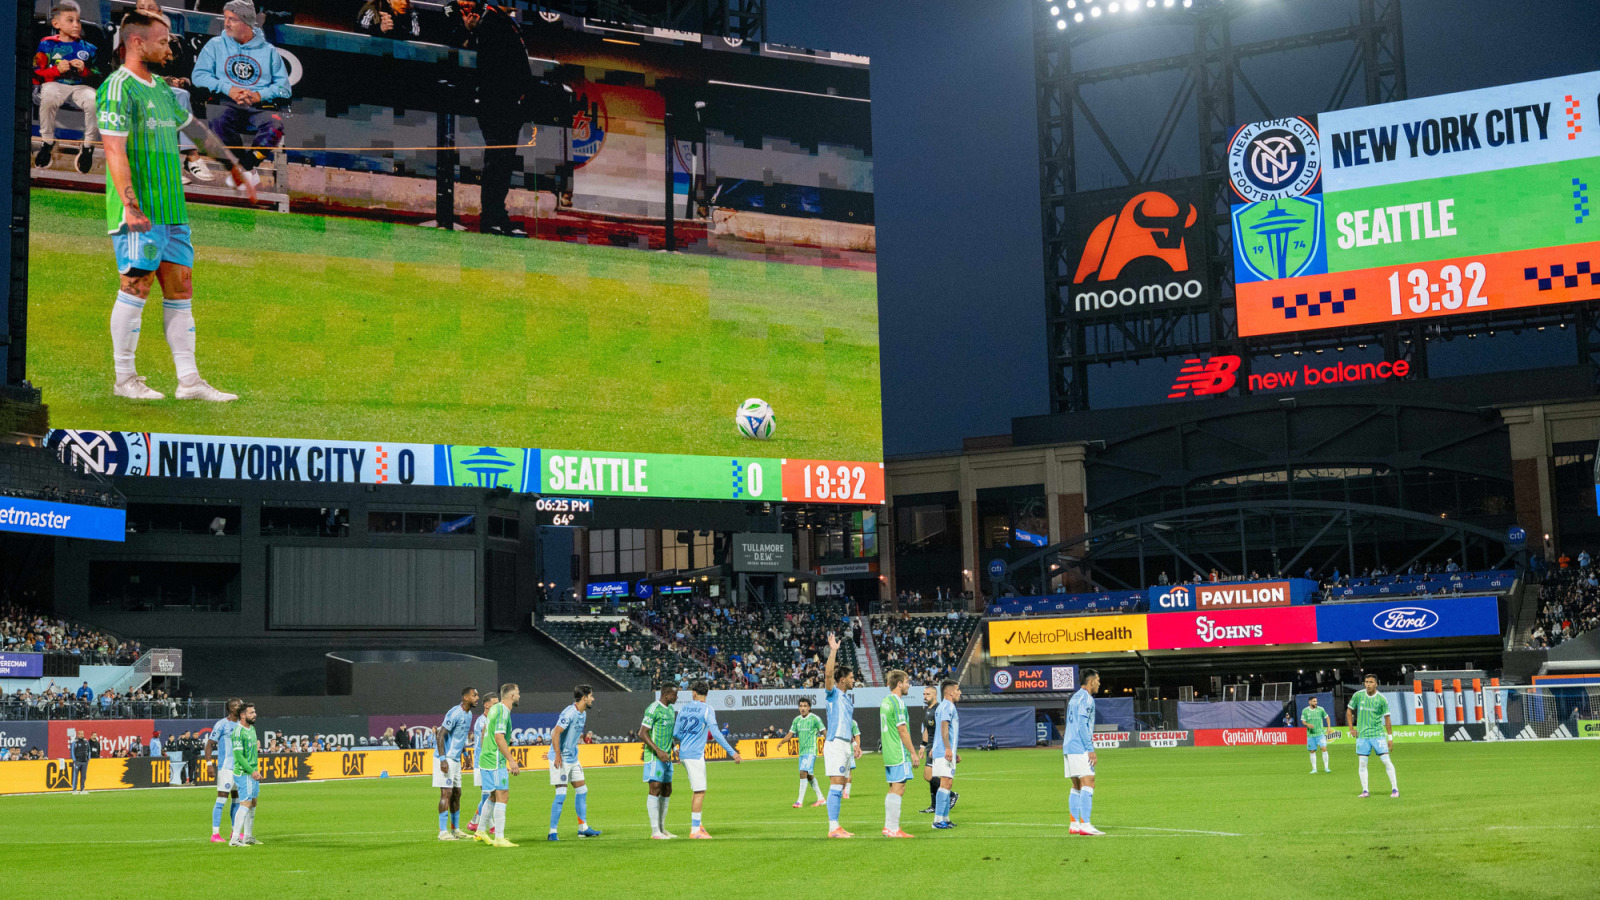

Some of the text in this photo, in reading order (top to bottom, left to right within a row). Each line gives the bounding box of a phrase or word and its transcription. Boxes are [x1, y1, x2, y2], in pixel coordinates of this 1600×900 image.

[100, 111, 126, 126] EQC
[1233, 118, 1316, 157] NEW YORK CITY
[1331, 124, 1399, 169] NEW
[1403, 112, 1481, 158] YORK
[1485, 102, 1551, 147] CITY
[1294, 160, 1317, 192] CLUB
[1336, 198, 1457, 250] SEATTLE
[1252, 240, 1306, 254] 19 74
[1075, 279, 1202, 312] moomoo
[1388, 262, 1488, 316] 13:32
[1248, 370, 1298, 391] new
[1303, 359, 1410, 386] balance
[158, 441, 365, 483] NEW YORK CITY
[398, 448, 415, 484] 0
[549, 455, 648, 492] SEATTLE
[747, 462, 763, 497] 0
[804, 464, 866, 500] 13:32
[536, 499, 590, 512] 06:25 PM
[553, 513, 575, 526] 64°
[1509, 532, 1523, 540] citi
[742, 543, 784, 552] TULLAMORE
[1159, 587, 1284, 608] citi PAVILION
[1384, 610, 1427, 629] Ford
[1018, 627, 1132, 644] MetroPlusHealth
[1015, 680, 1048, 688] BINGO!
[1019, 670, 1043, 679] PLAY
[742, 695, 758, 706] MLS
[758, 694, 774, 706] CUP
[679, 716, 700, 734] 22
[1418, 730, 1441, 738] Upper
[264, 731, 355, 752] Rgscom
[1092, 732, 1129, 741] SCOUNT
[1140, 731, 1188, 741] DISCOUNT
[1222, 730, 1287, 745] Captain Morgan
[603, 745, 620, 764] CAT
[755, 741, 768, 757] CAT
[343, 753, 366, 775] CAT
[403, 751, 425, 773] CAT
